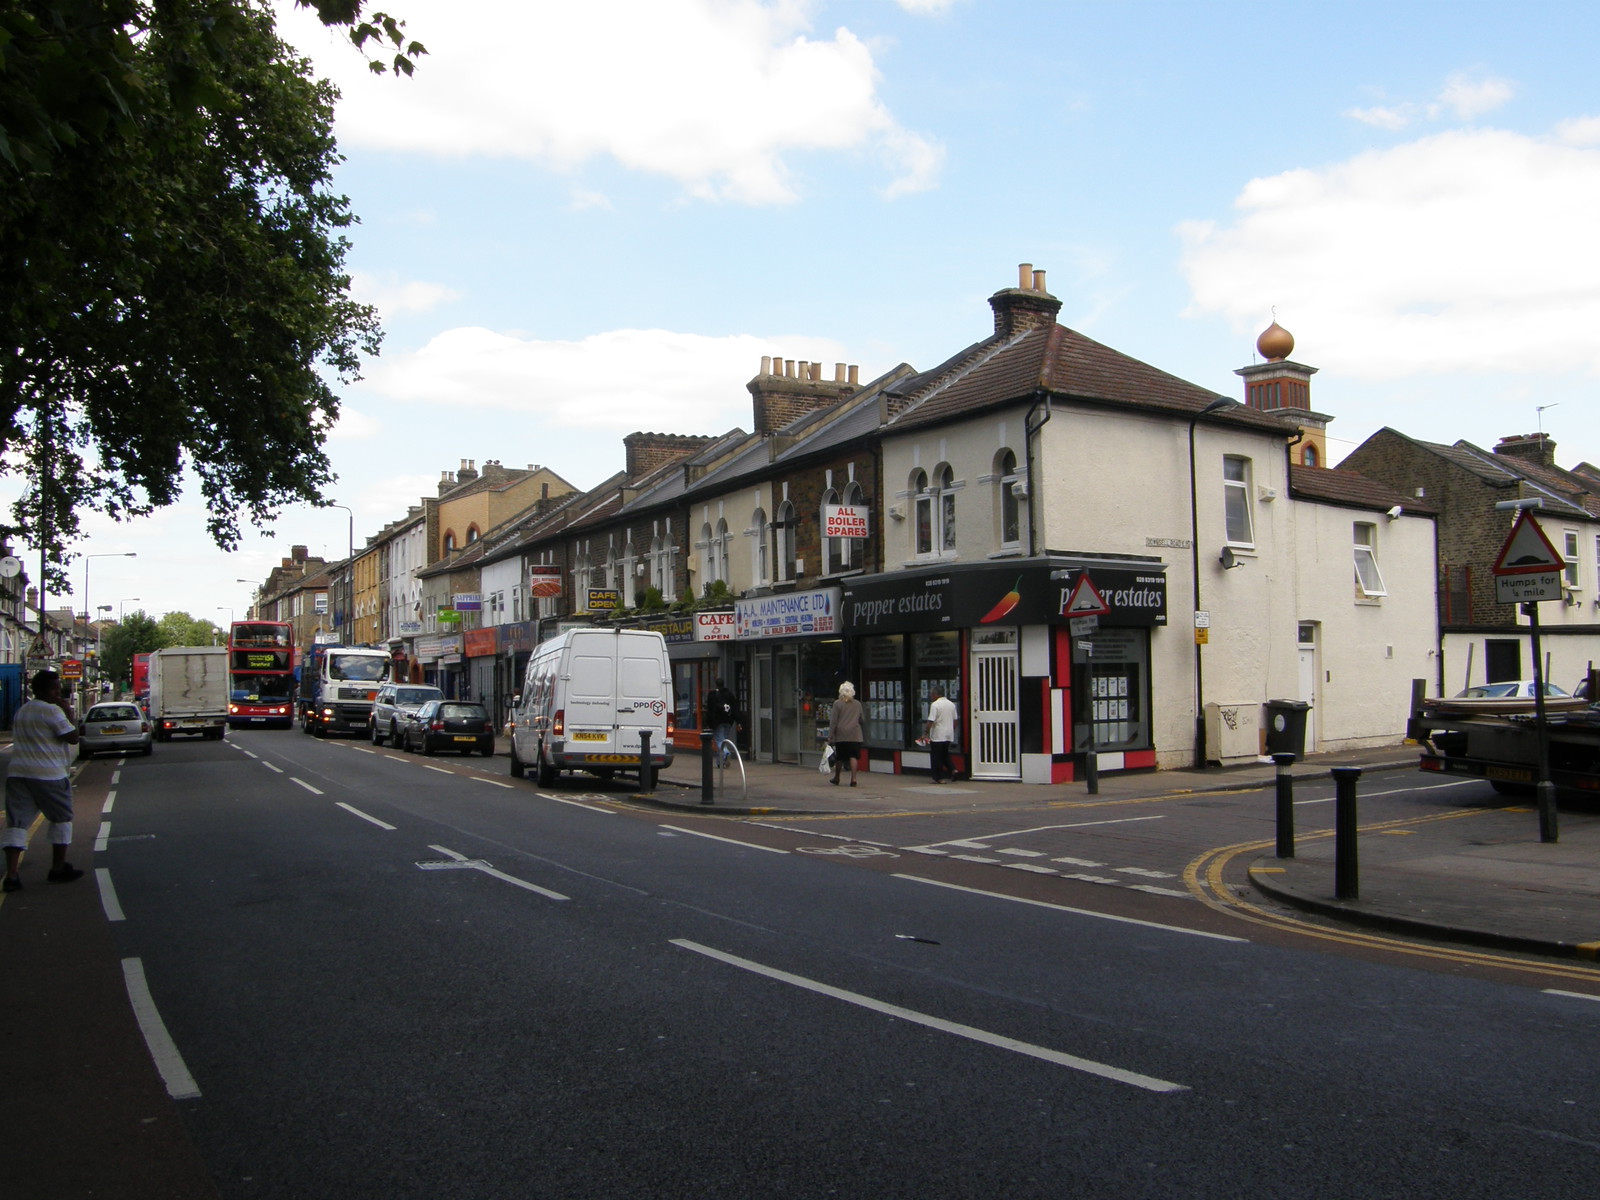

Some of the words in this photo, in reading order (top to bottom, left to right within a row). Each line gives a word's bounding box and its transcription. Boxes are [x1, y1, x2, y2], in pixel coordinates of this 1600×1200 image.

[837, 507, 857, 516] ALL
[828, 516, 866, 526] BOILER
[827, 526, 868, 537] SPARES
[1501, 577, 1536, 588] Humps
[1541, 576, 1556, 585] for
[589, 591, 617, 600] CAFE
[1524, 587, 1545, 597] mile
[589, 600, 617, 609] OPEN
[743, 603, 757, 618] A.A.
[759, 596, 809, 616] MAINTENANCE
[812, 593, 824, 611] LTD
[1059, 587, 1114, 615] per
[1114, 586, 1162, 608] estates
[852, 597, 896, 627] pepper
[898, 590, 943, 613] estates
[698, 614, 735, 626] CAFE
